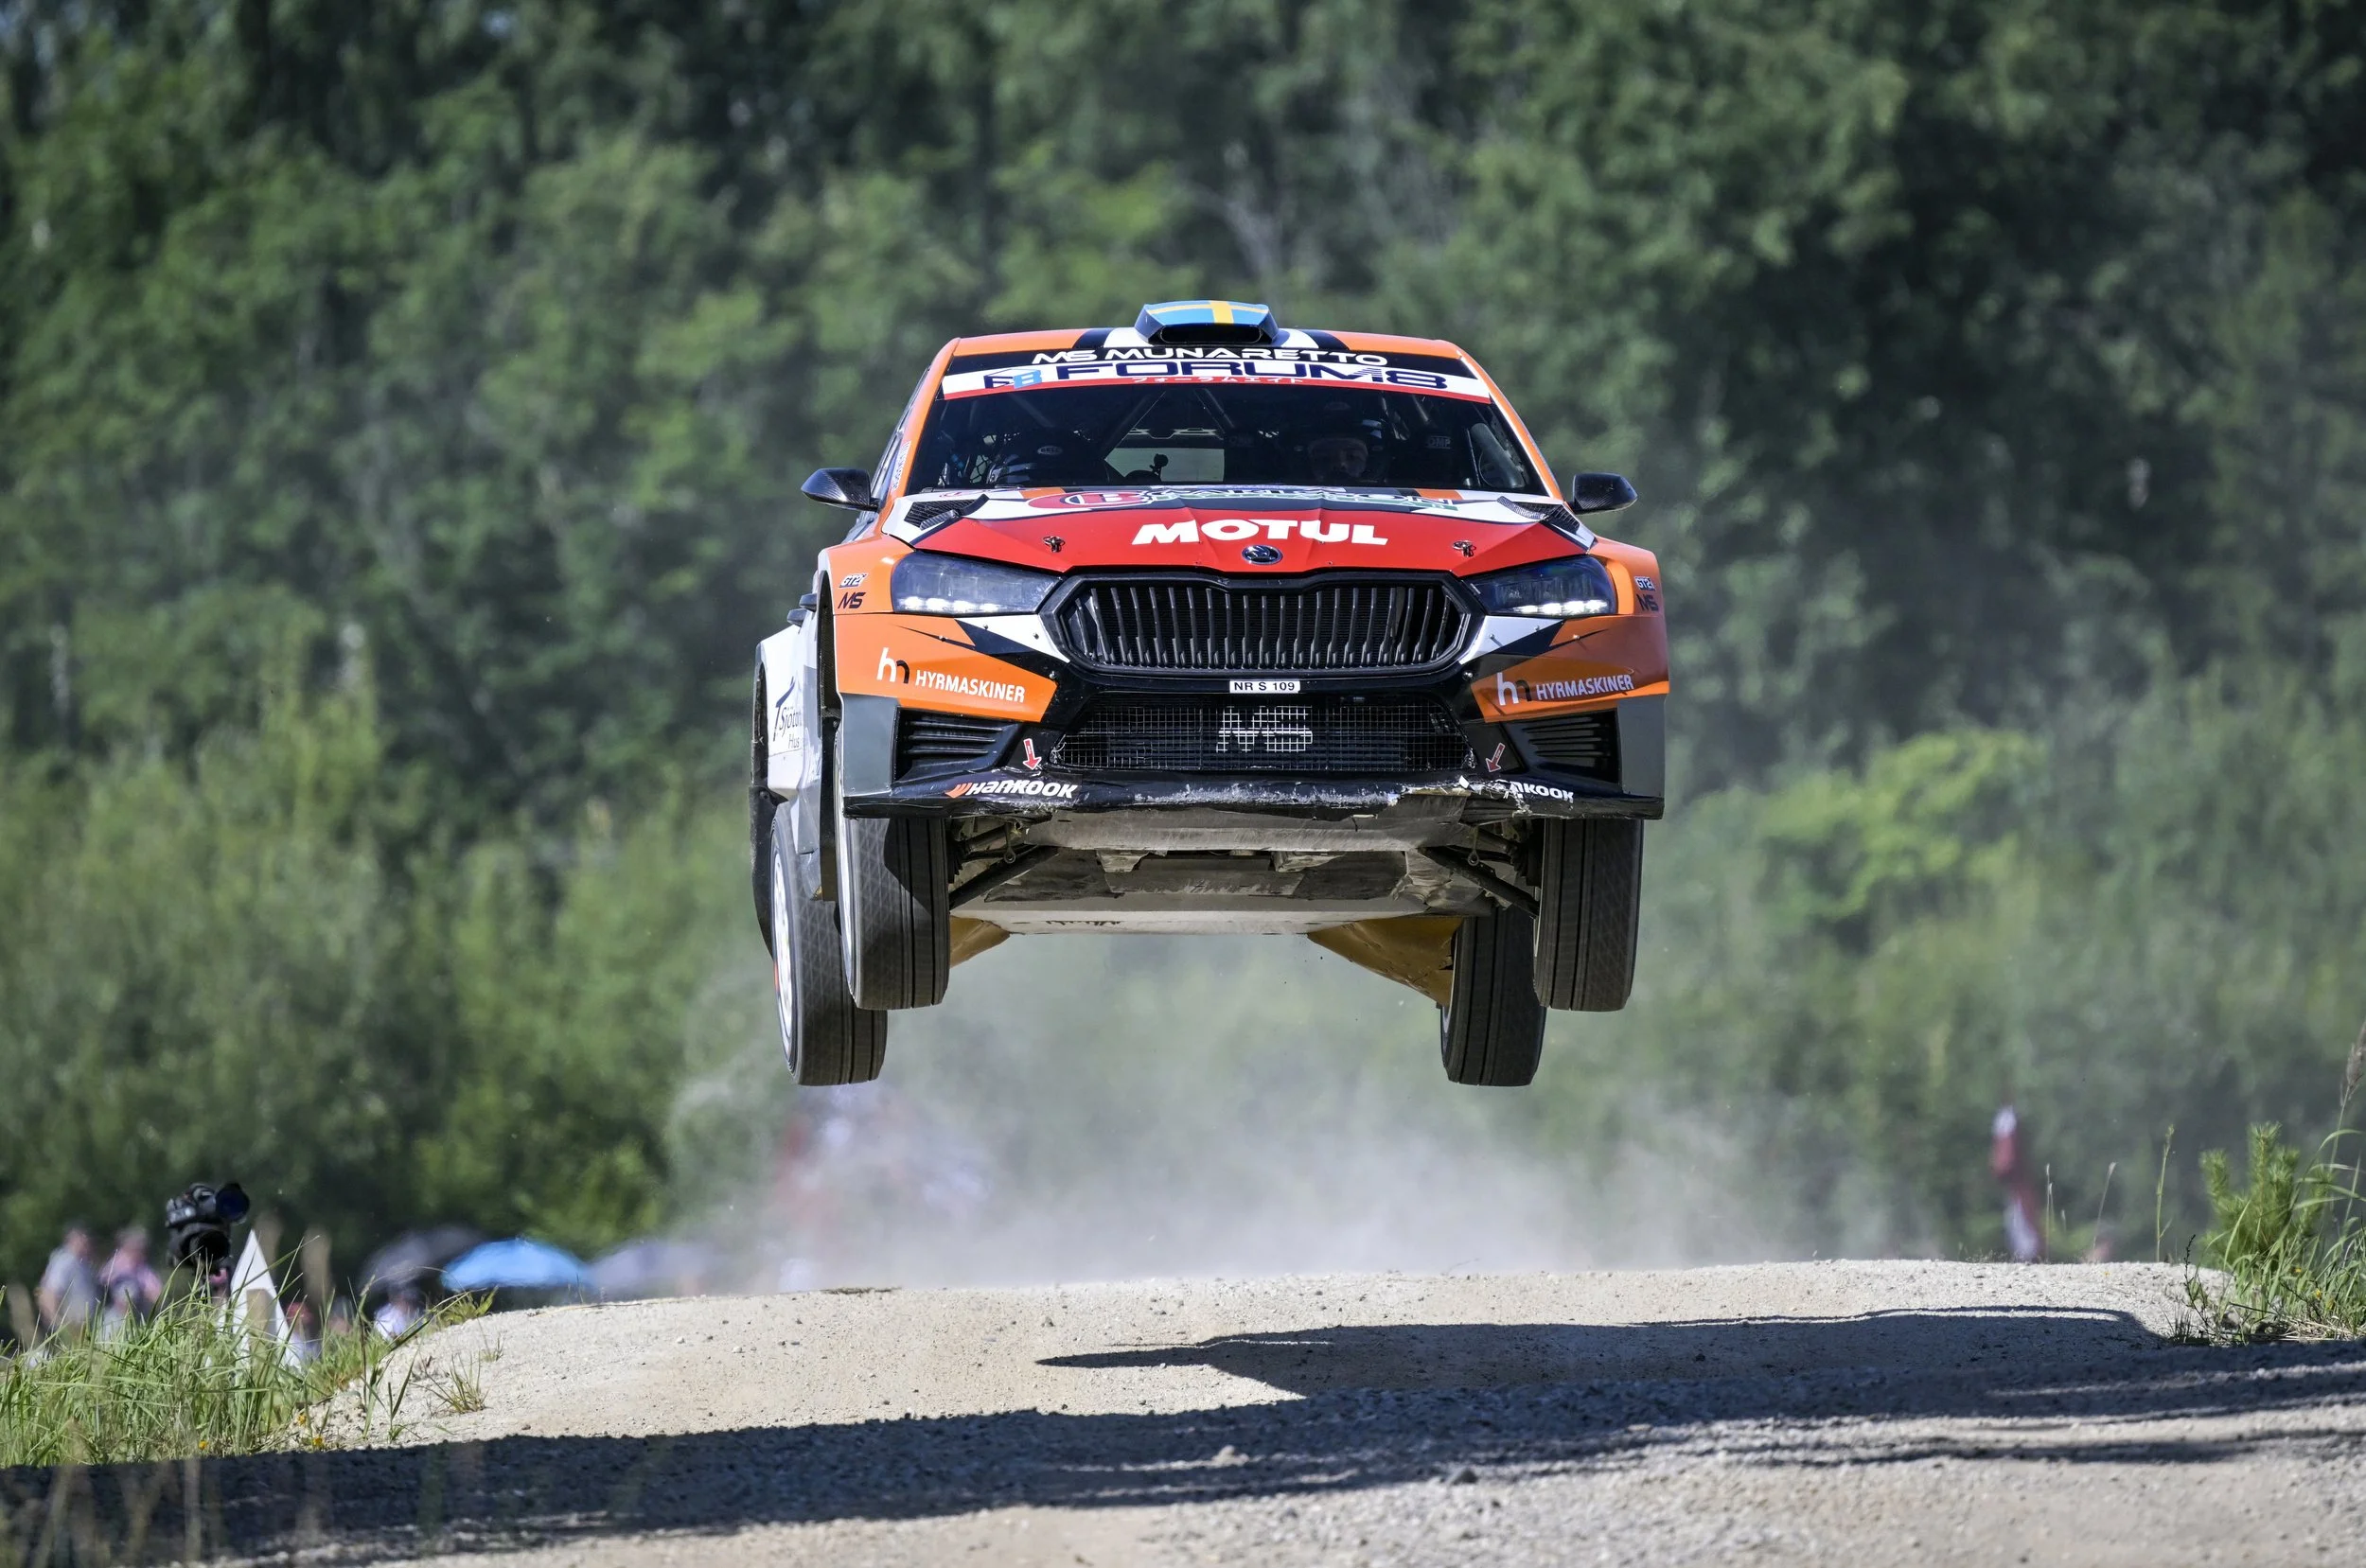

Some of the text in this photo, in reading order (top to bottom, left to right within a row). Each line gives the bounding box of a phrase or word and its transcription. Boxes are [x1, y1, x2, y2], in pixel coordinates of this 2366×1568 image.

[1031, 347, 1388, 366] MS MUNARETTO
[1055, 361, 1448, 389] FORUM8
[1131, 519, 1388, 546] MOTUL
[838, 591, 867, 609] MS
[1635, 593, 1659, 611] MS
[915, 669, 1025, 703] HYRMASKINER
[1233, 681, 1295, 691] NR S 109
[1536, 674, 1633, 700] HYRMASKINER
[1215, 705, 1314, 752] MS
